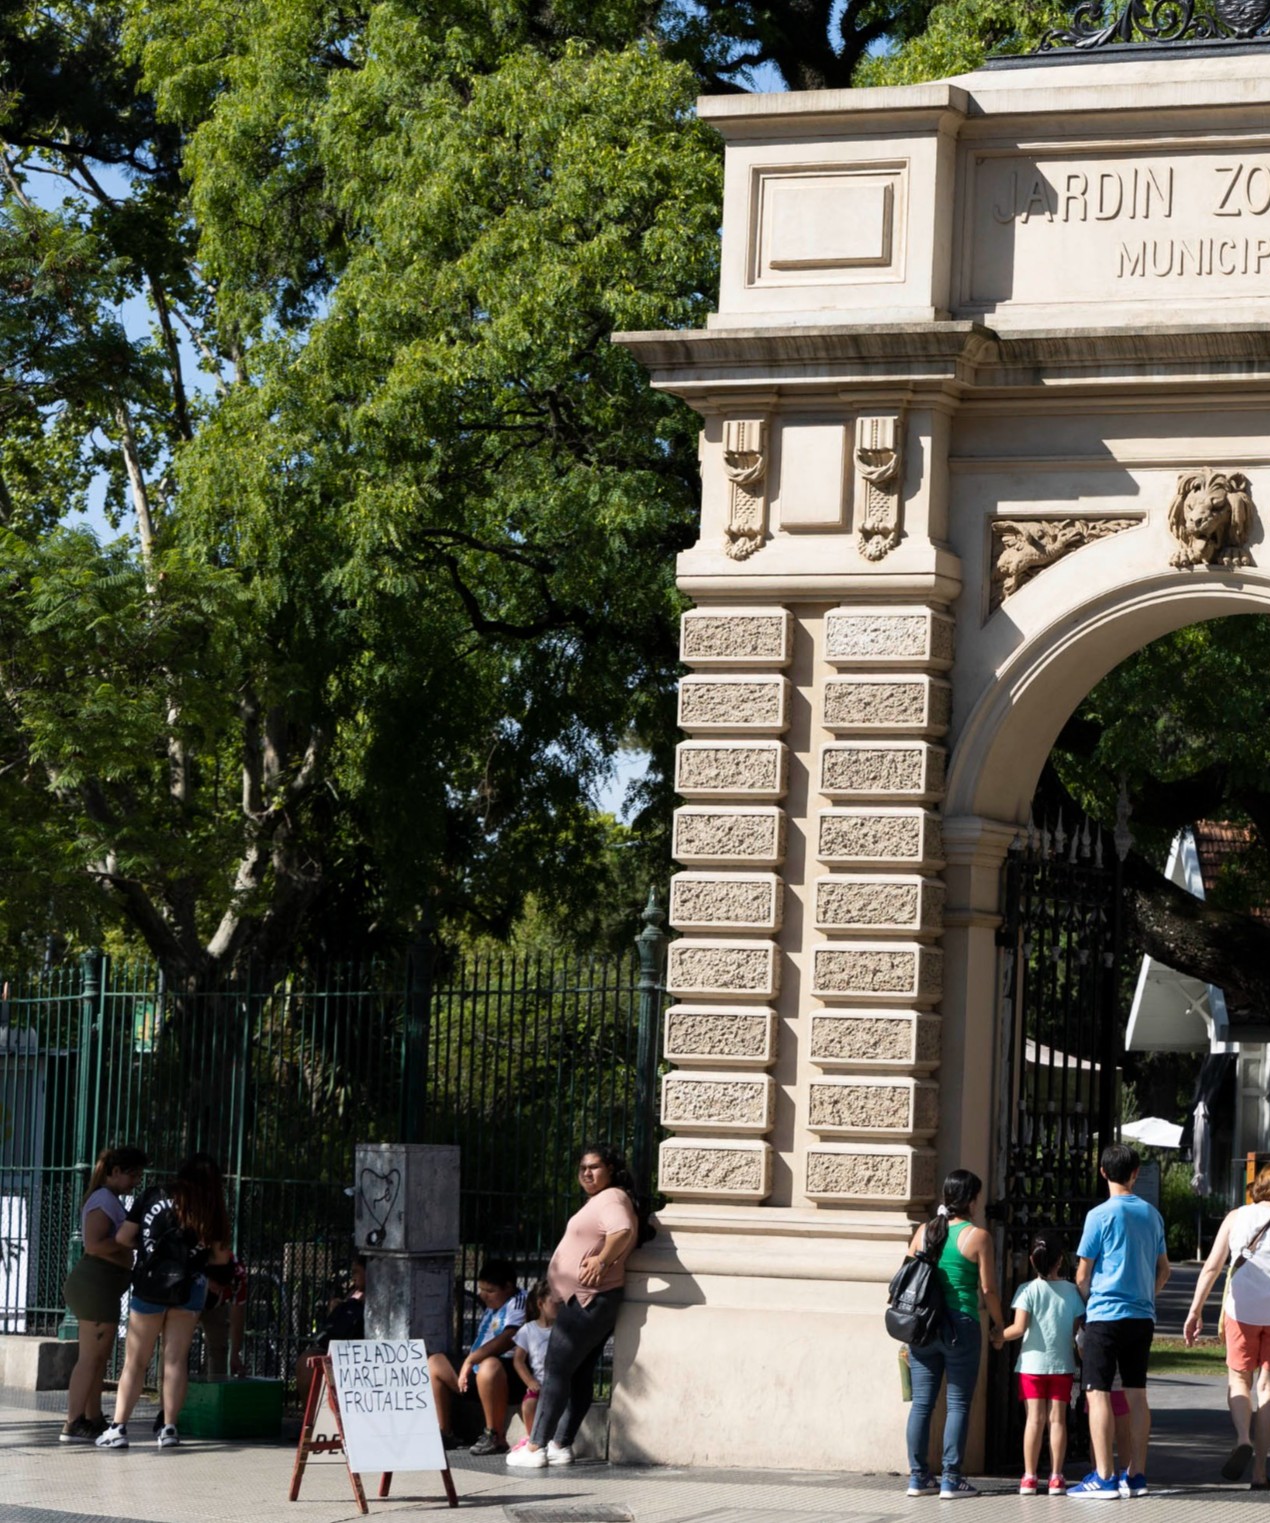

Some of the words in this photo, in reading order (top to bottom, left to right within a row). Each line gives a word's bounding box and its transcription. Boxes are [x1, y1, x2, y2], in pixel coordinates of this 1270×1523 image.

[993, 166, 1174, 225] JARDIN
[340, 1365, 430, 1388] MARCIANOS
[344, 1390, 428, 1413] FRUTALES
